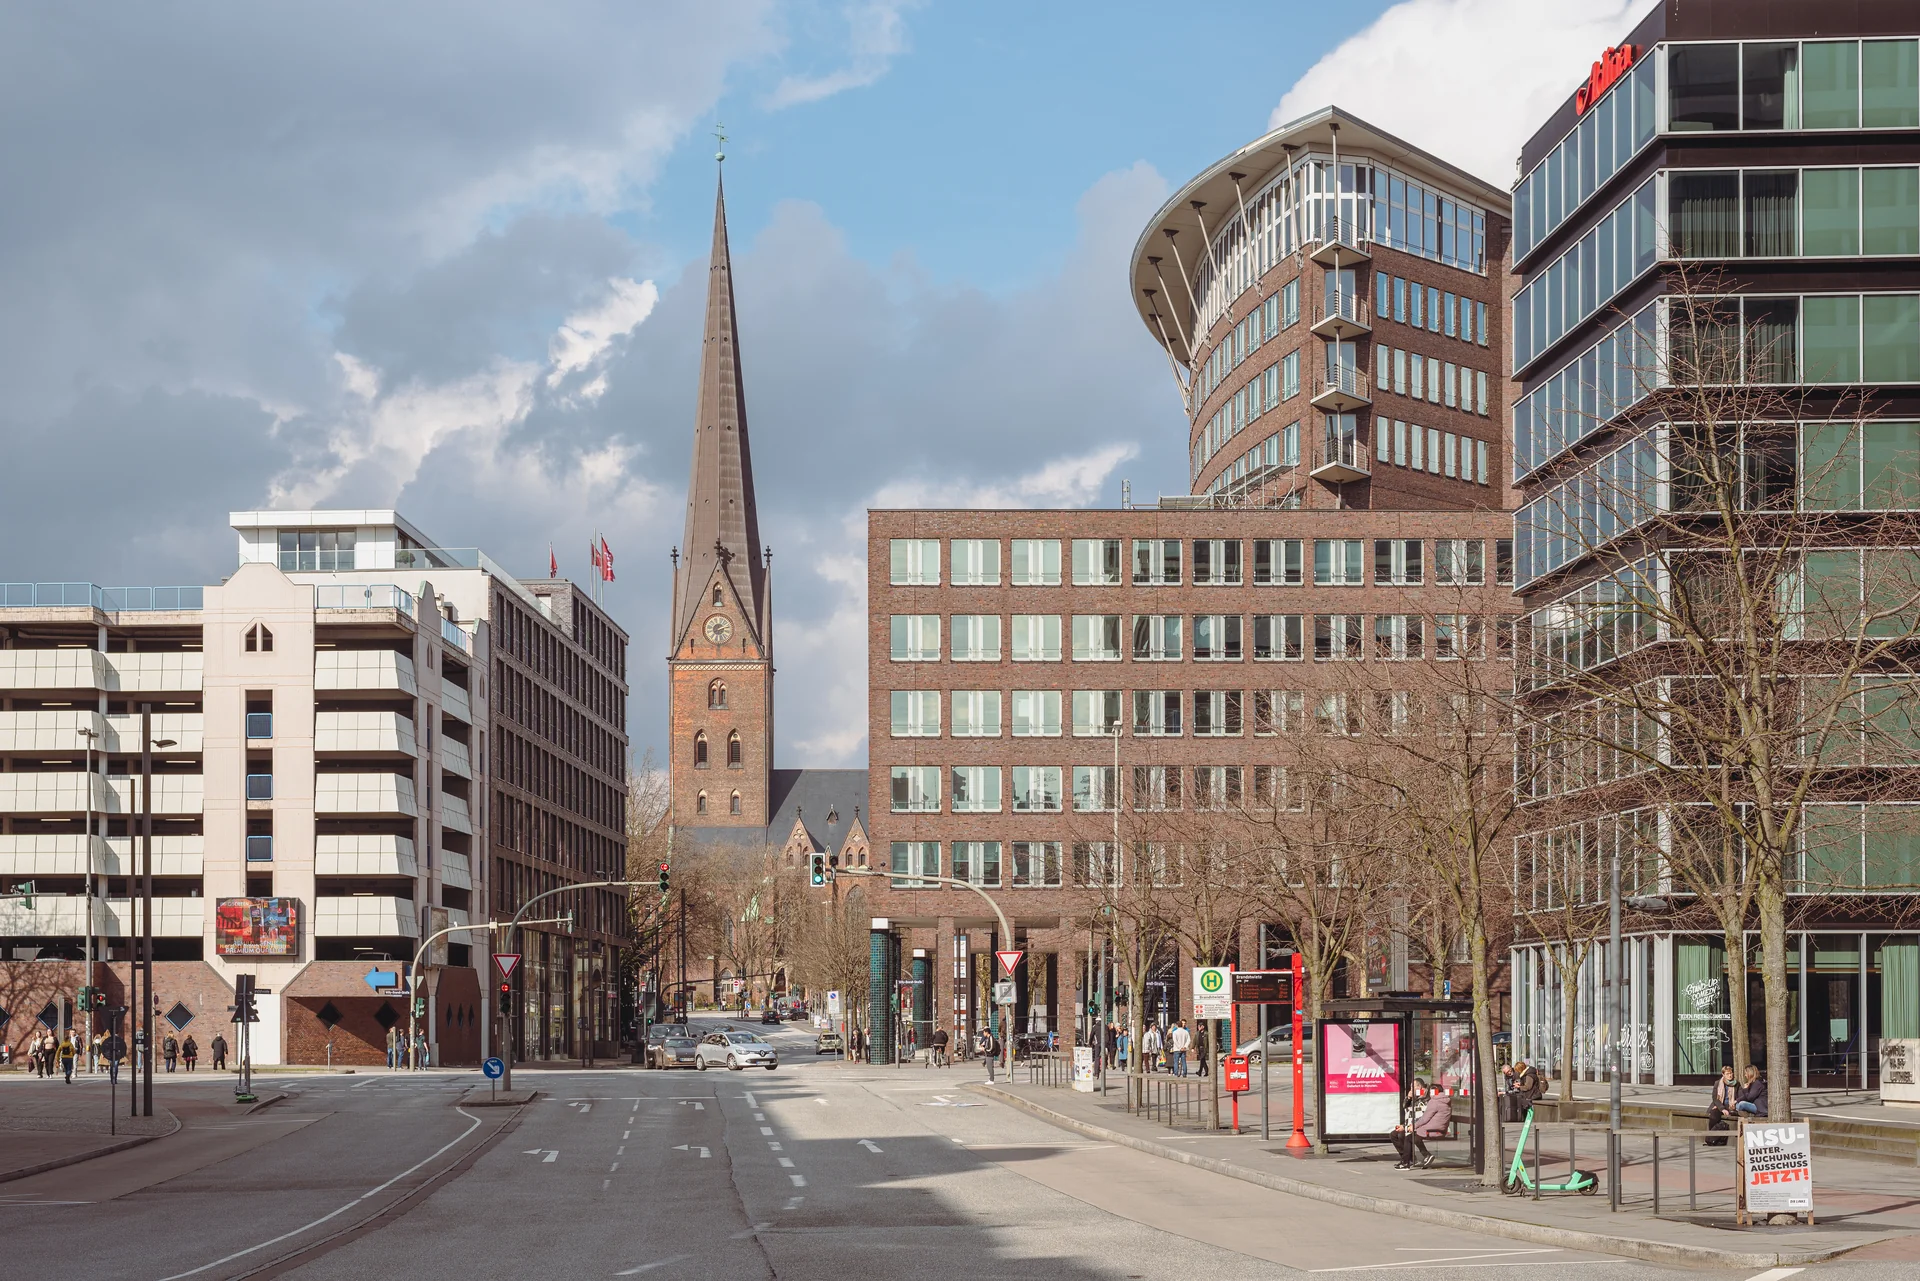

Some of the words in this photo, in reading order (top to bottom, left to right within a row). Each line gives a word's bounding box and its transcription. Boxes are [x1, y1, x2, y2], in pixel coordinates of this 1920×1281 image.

[1346, 1064, 1386, 1079] Flink
[1746, 1127, 1805, 1148] NSU-
[1748, 1146, 1784, 1156] UNTER-
[1749, 1152, 1807, 1164] SUCHUNGS-
[1750, 1160, 1809, 1172] AUSSCHUSS
[1750, 1167, 1810, 1186] JETZT!
